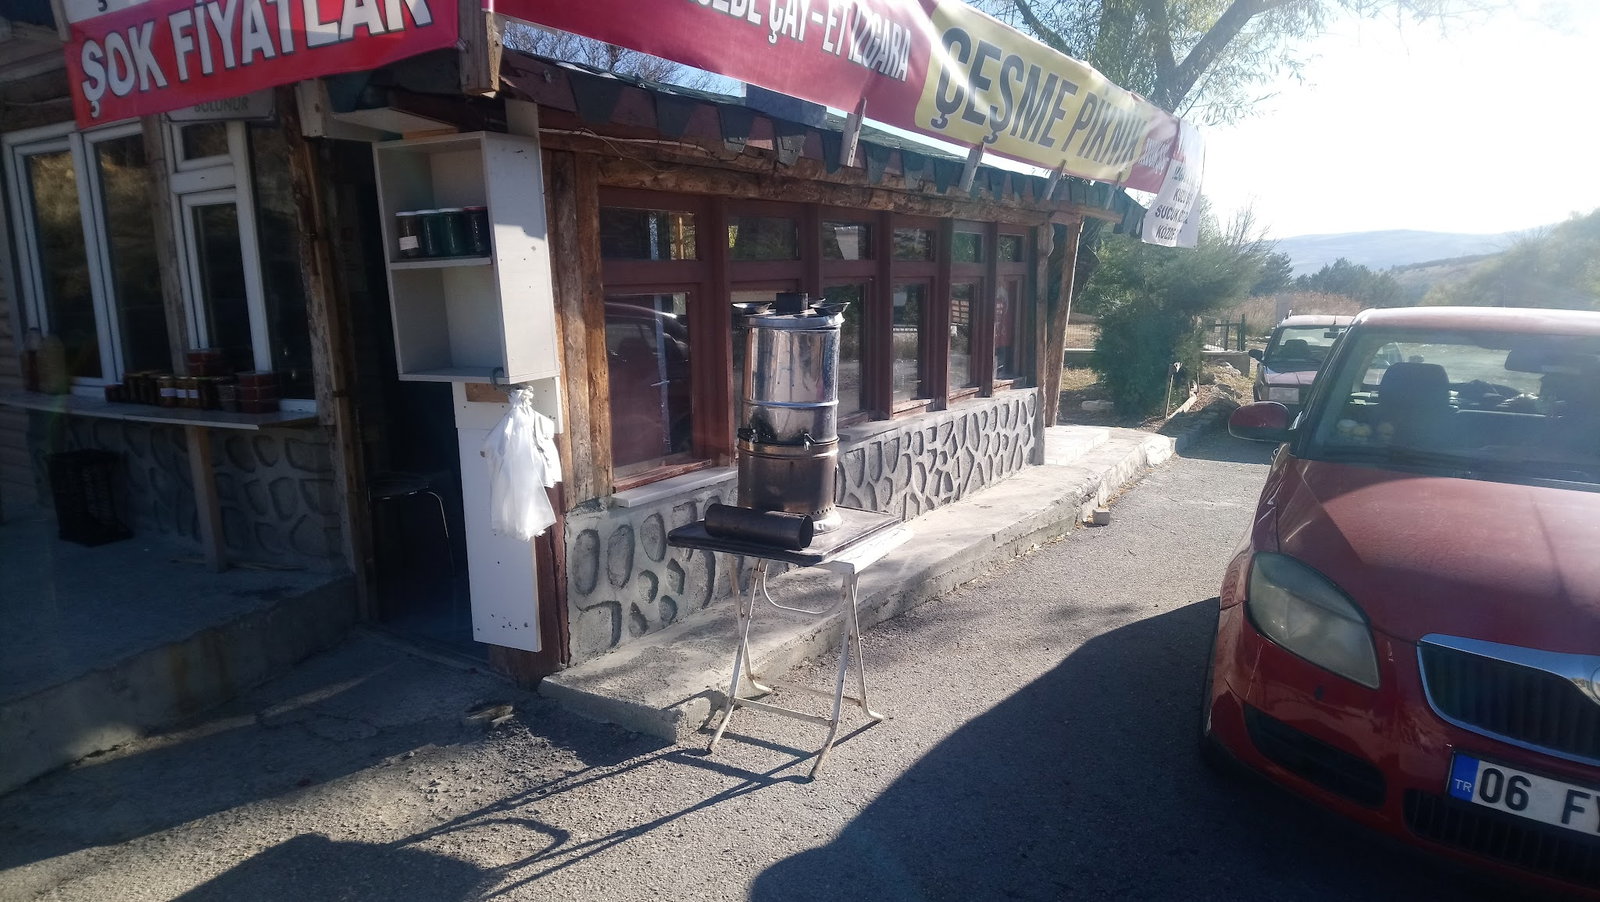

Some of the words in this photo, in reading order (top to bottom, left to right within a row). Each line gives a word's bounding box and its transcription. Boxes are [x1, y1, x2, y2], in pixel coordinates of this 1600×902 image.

[81, 20, 168, 118] ŞOK
[930, 27, 1078, 147] ÇEŞME
[1455, 778, 1472, 793] TR
[1479, 767, 1532, 811] 06
[1560, 788, 1600, 834] F
